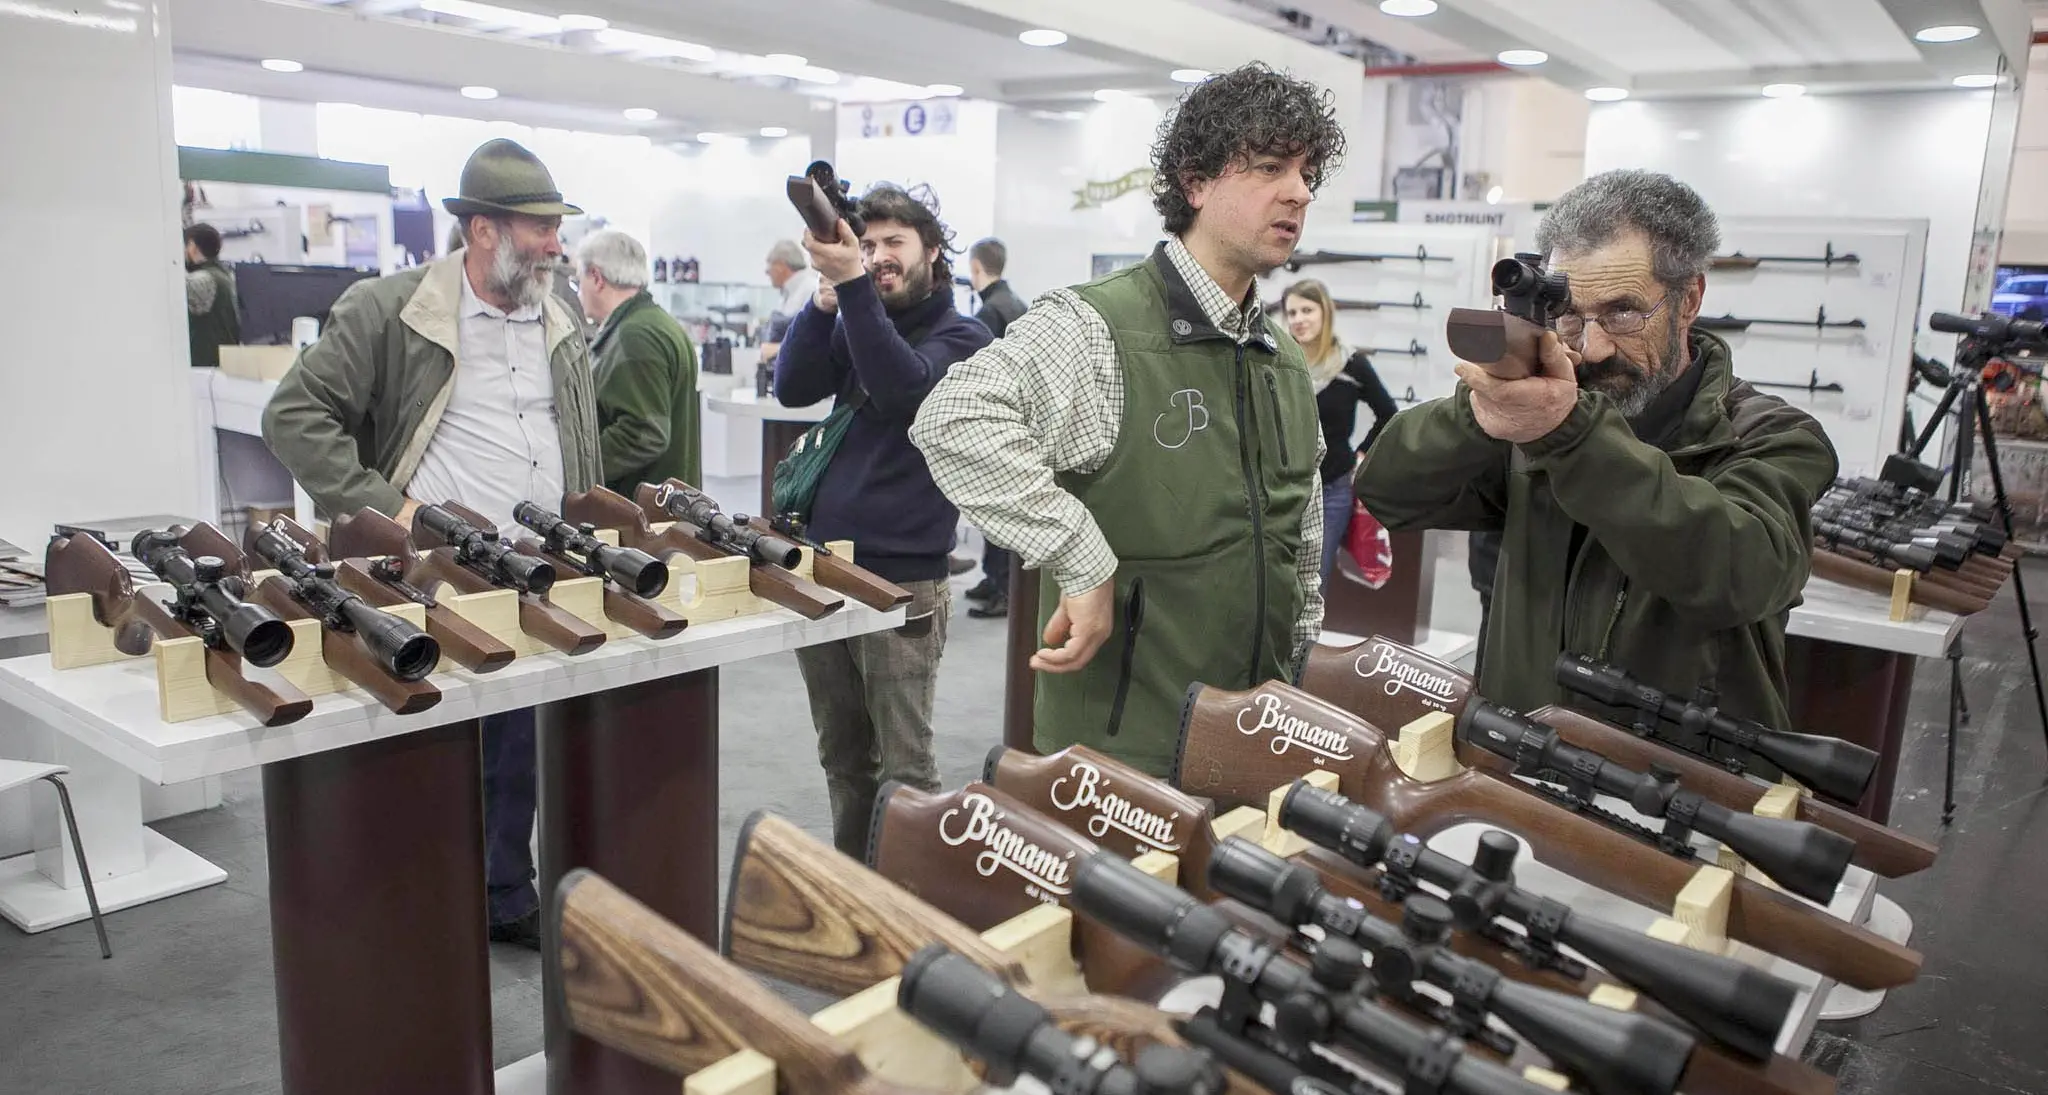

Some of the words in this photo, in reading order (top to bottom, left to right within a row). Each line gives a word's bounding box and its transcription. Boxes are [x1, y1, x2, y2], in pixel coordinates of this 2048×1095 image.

[1355, 643, 1458, 703] Bignami
[1237, 694, 1354, 761] Bignami
[939, 793, 1073, 895] Bignami
[1050, 762, 1181, 851] Bignami
